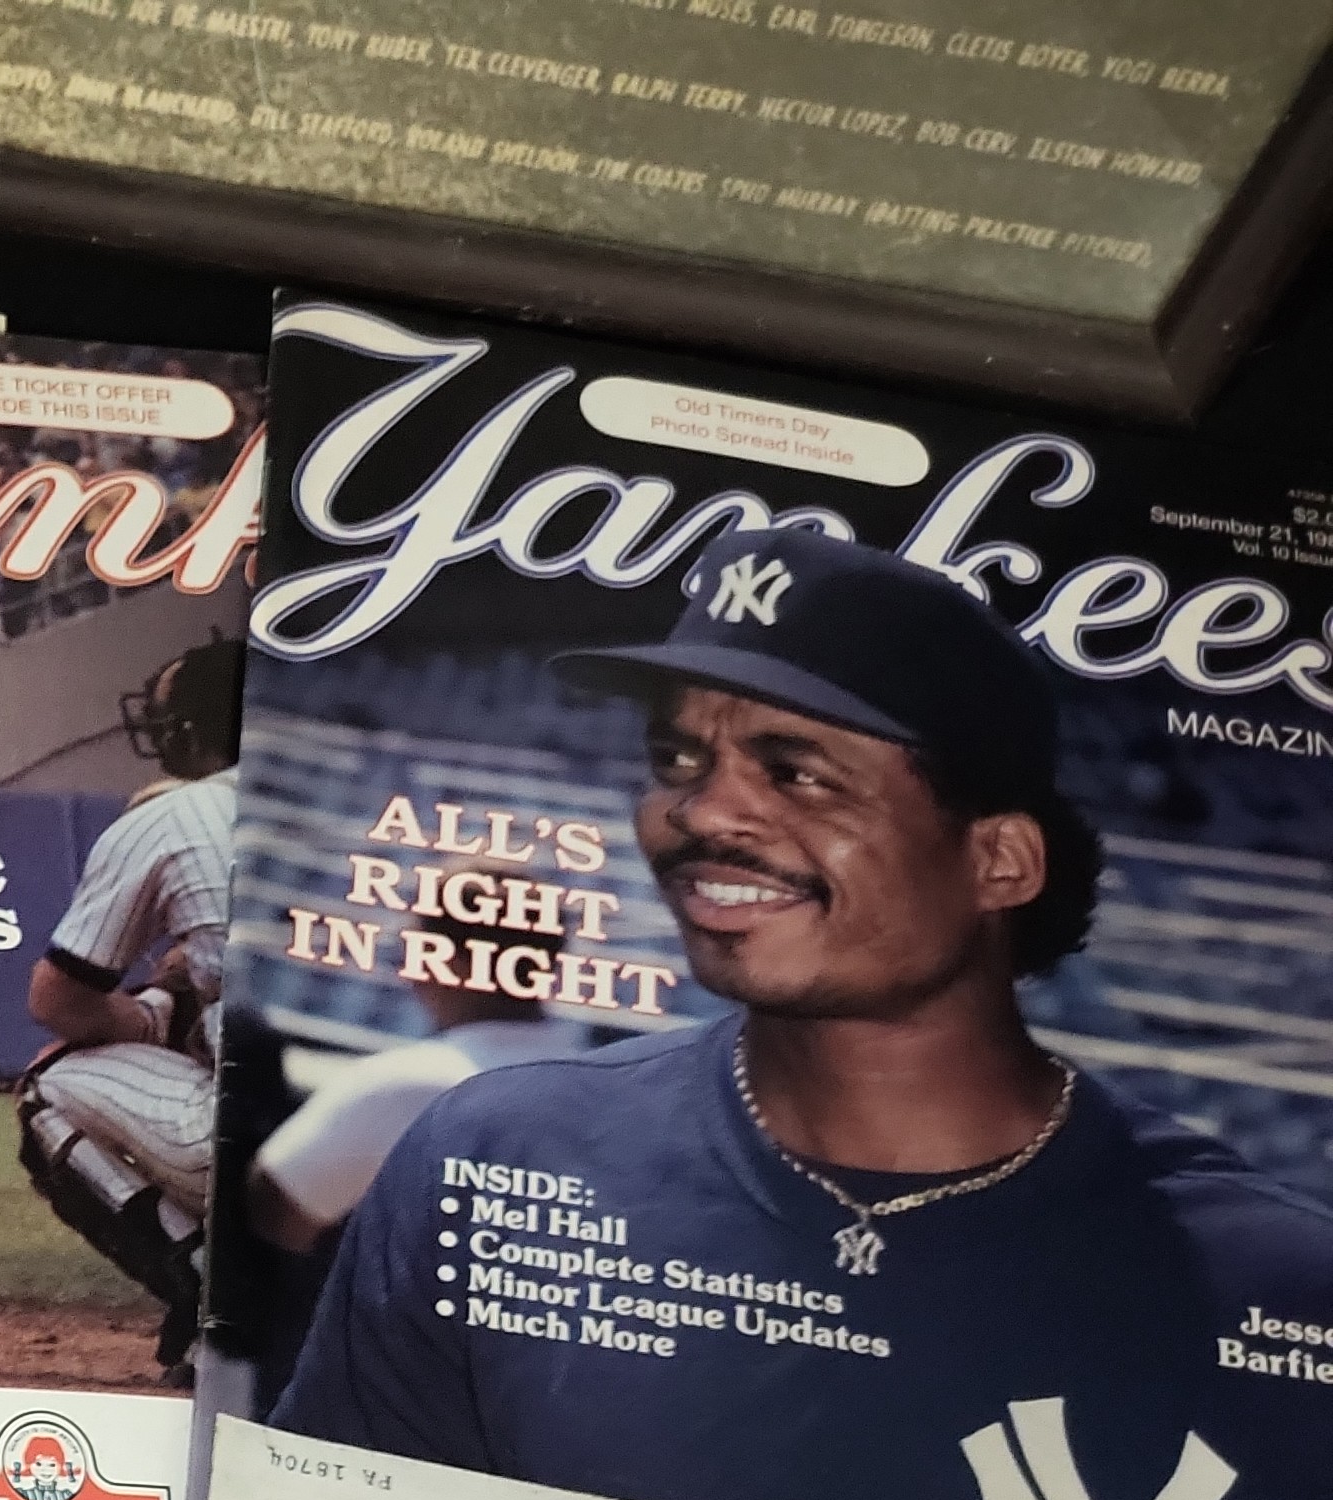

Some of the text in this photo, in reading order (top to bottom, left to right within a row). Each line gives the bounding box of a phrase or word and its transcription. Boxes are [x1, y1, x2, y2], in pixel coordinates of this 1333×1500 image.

[15, 377, 88, 398] TICKET
[96, 384, 171, 404] OFFER
[41, 401, 90, 420] THIS
[96, 405, 163, 425] ISSUE
[651, 416, 855, 466] Photo Spread Inside
[675, 398, 831, 440] Old Timers Day
[1150, 505, 1264, 538] September
[368, 796, 606, 873] ALL'S
[346, 853, 619, 940] RIGHT
[288, 907, 676, 1015] IN RIGHT
[443, 1157, 595, 1207] INSIDE:
[470, 1195, 627, 1246] Mel Hall
[469, 1230, 844, 1316] Complete Statistics
[467, 1298, 677, 1358] Much More
[468, 1263, 891, 1359] Minor League Updates
